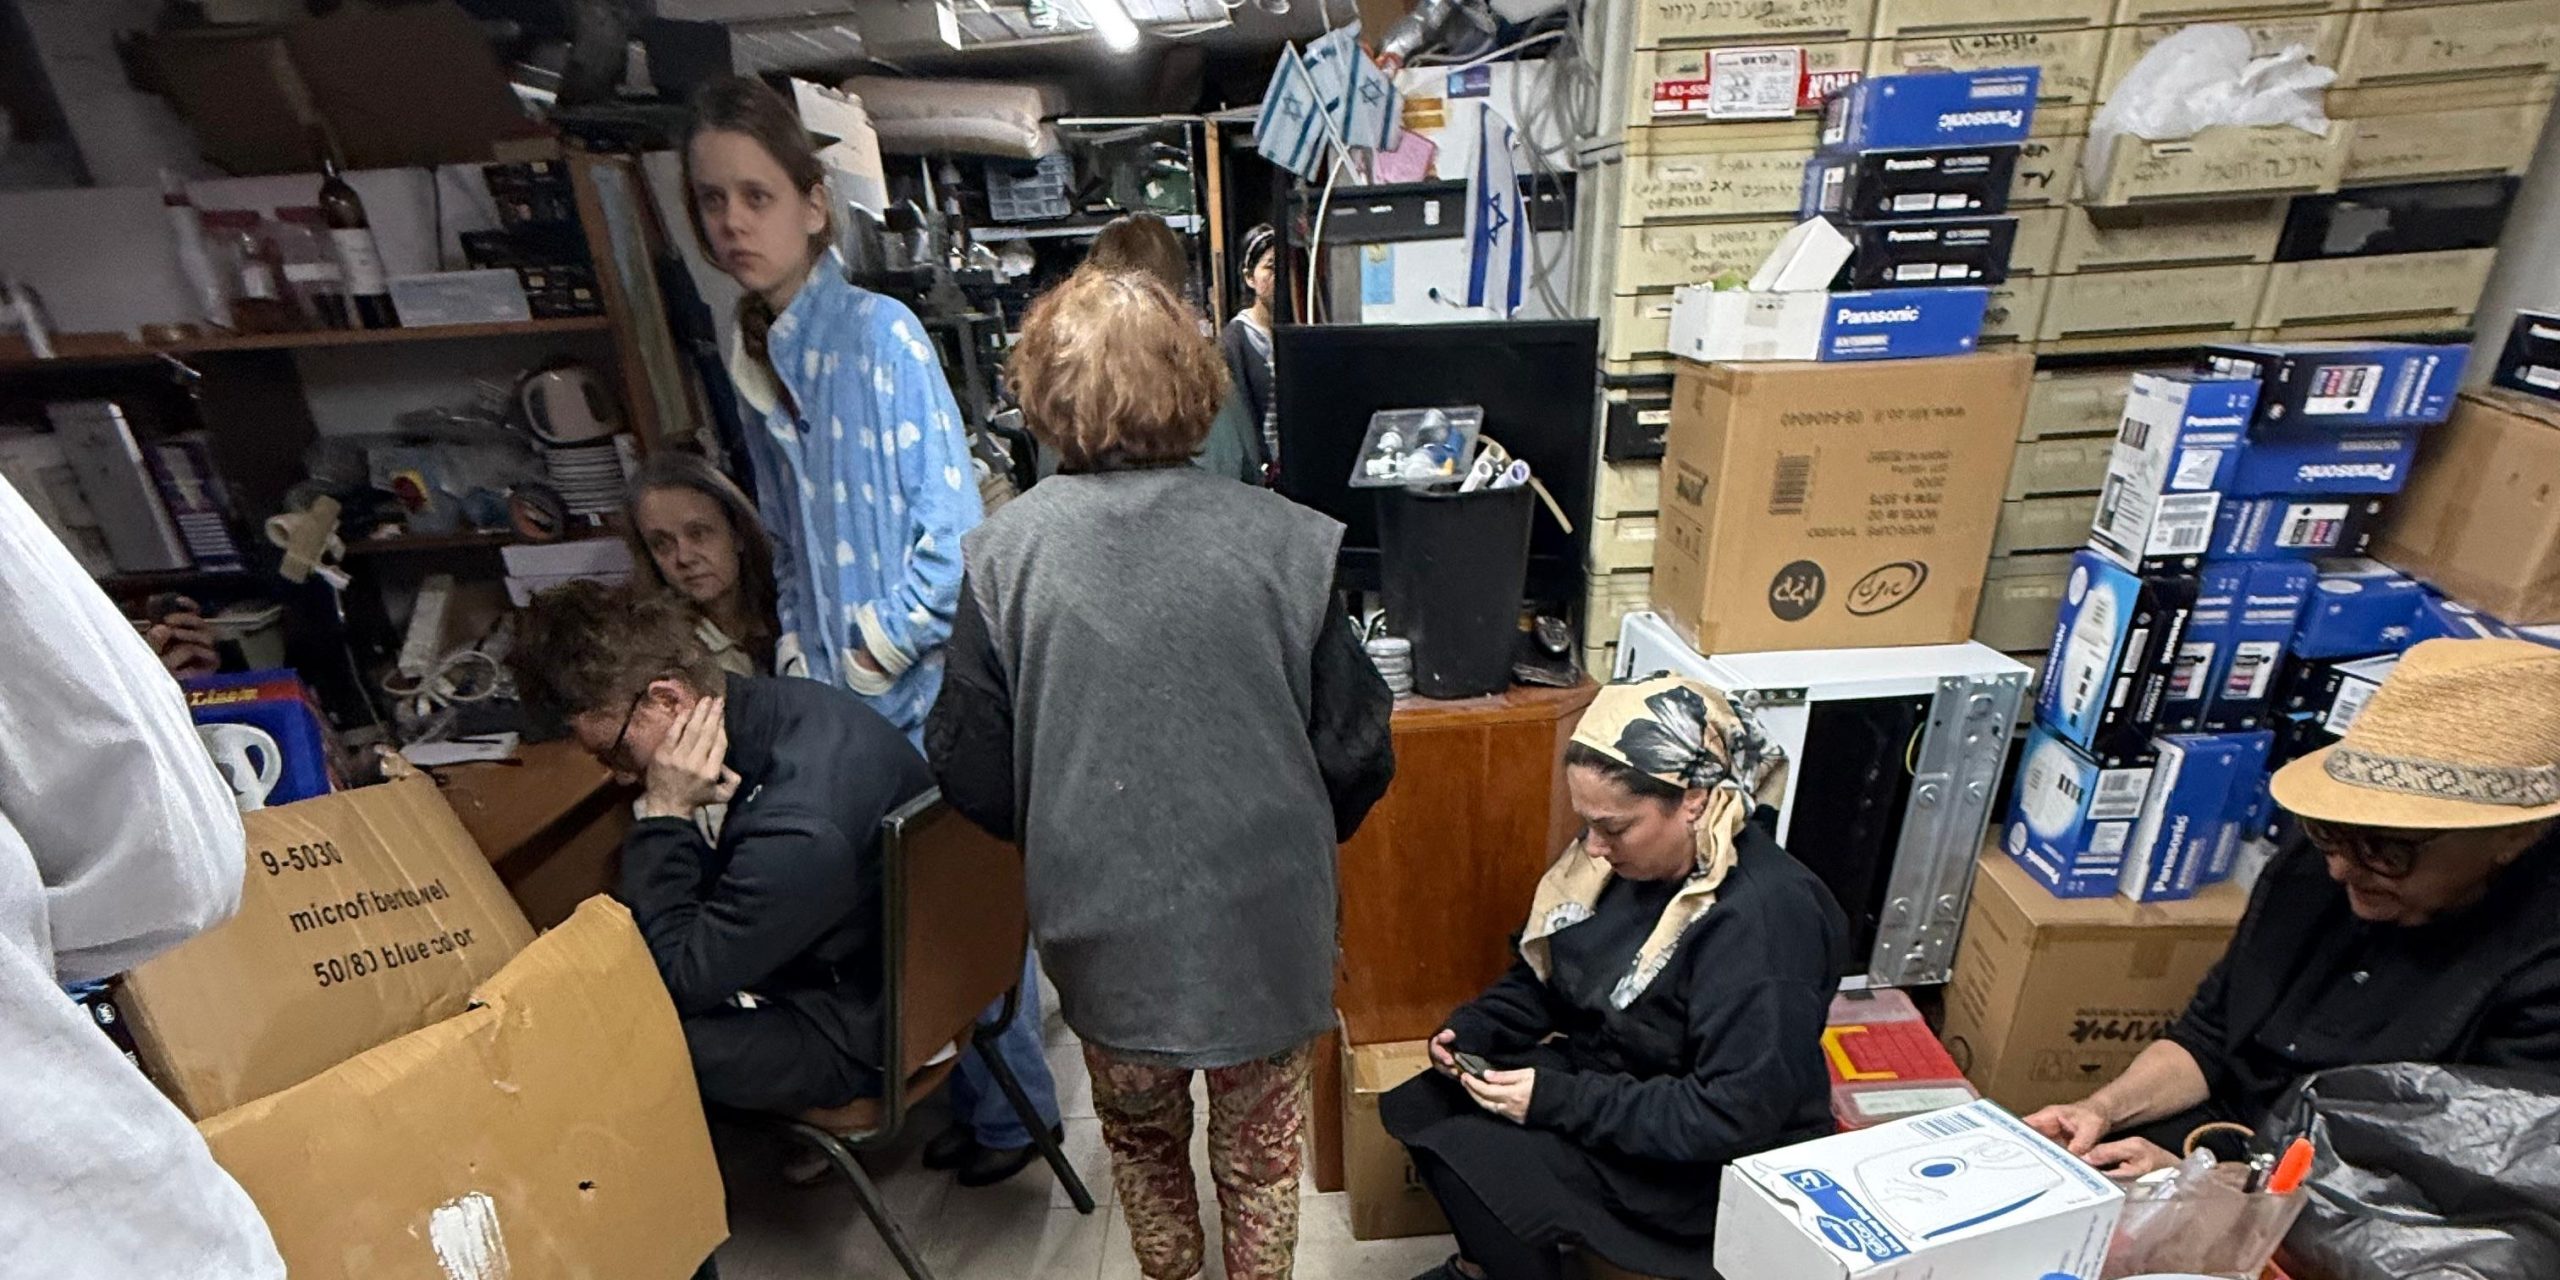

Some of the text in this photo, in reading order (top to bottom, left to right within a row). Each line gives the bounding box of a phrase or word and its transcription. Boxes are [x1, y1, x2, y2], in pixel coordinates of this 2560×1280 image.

[1938, 109, 2024, 131] Panasonic
[1885, 157, 1937, 171] Panasonic
[1888, 229, 1938, 242] Panasonic
[1837, 305, 1920, 325] Panasonic
[2297, 464, 2397, 483] Panasonic
[2160, 608, 2188, 665] Panasonic
[260, 841, 343, 876] 9-5030
[2151, 814, 2190, 892] Panasonic
[380, 942, 431, 969] blue
